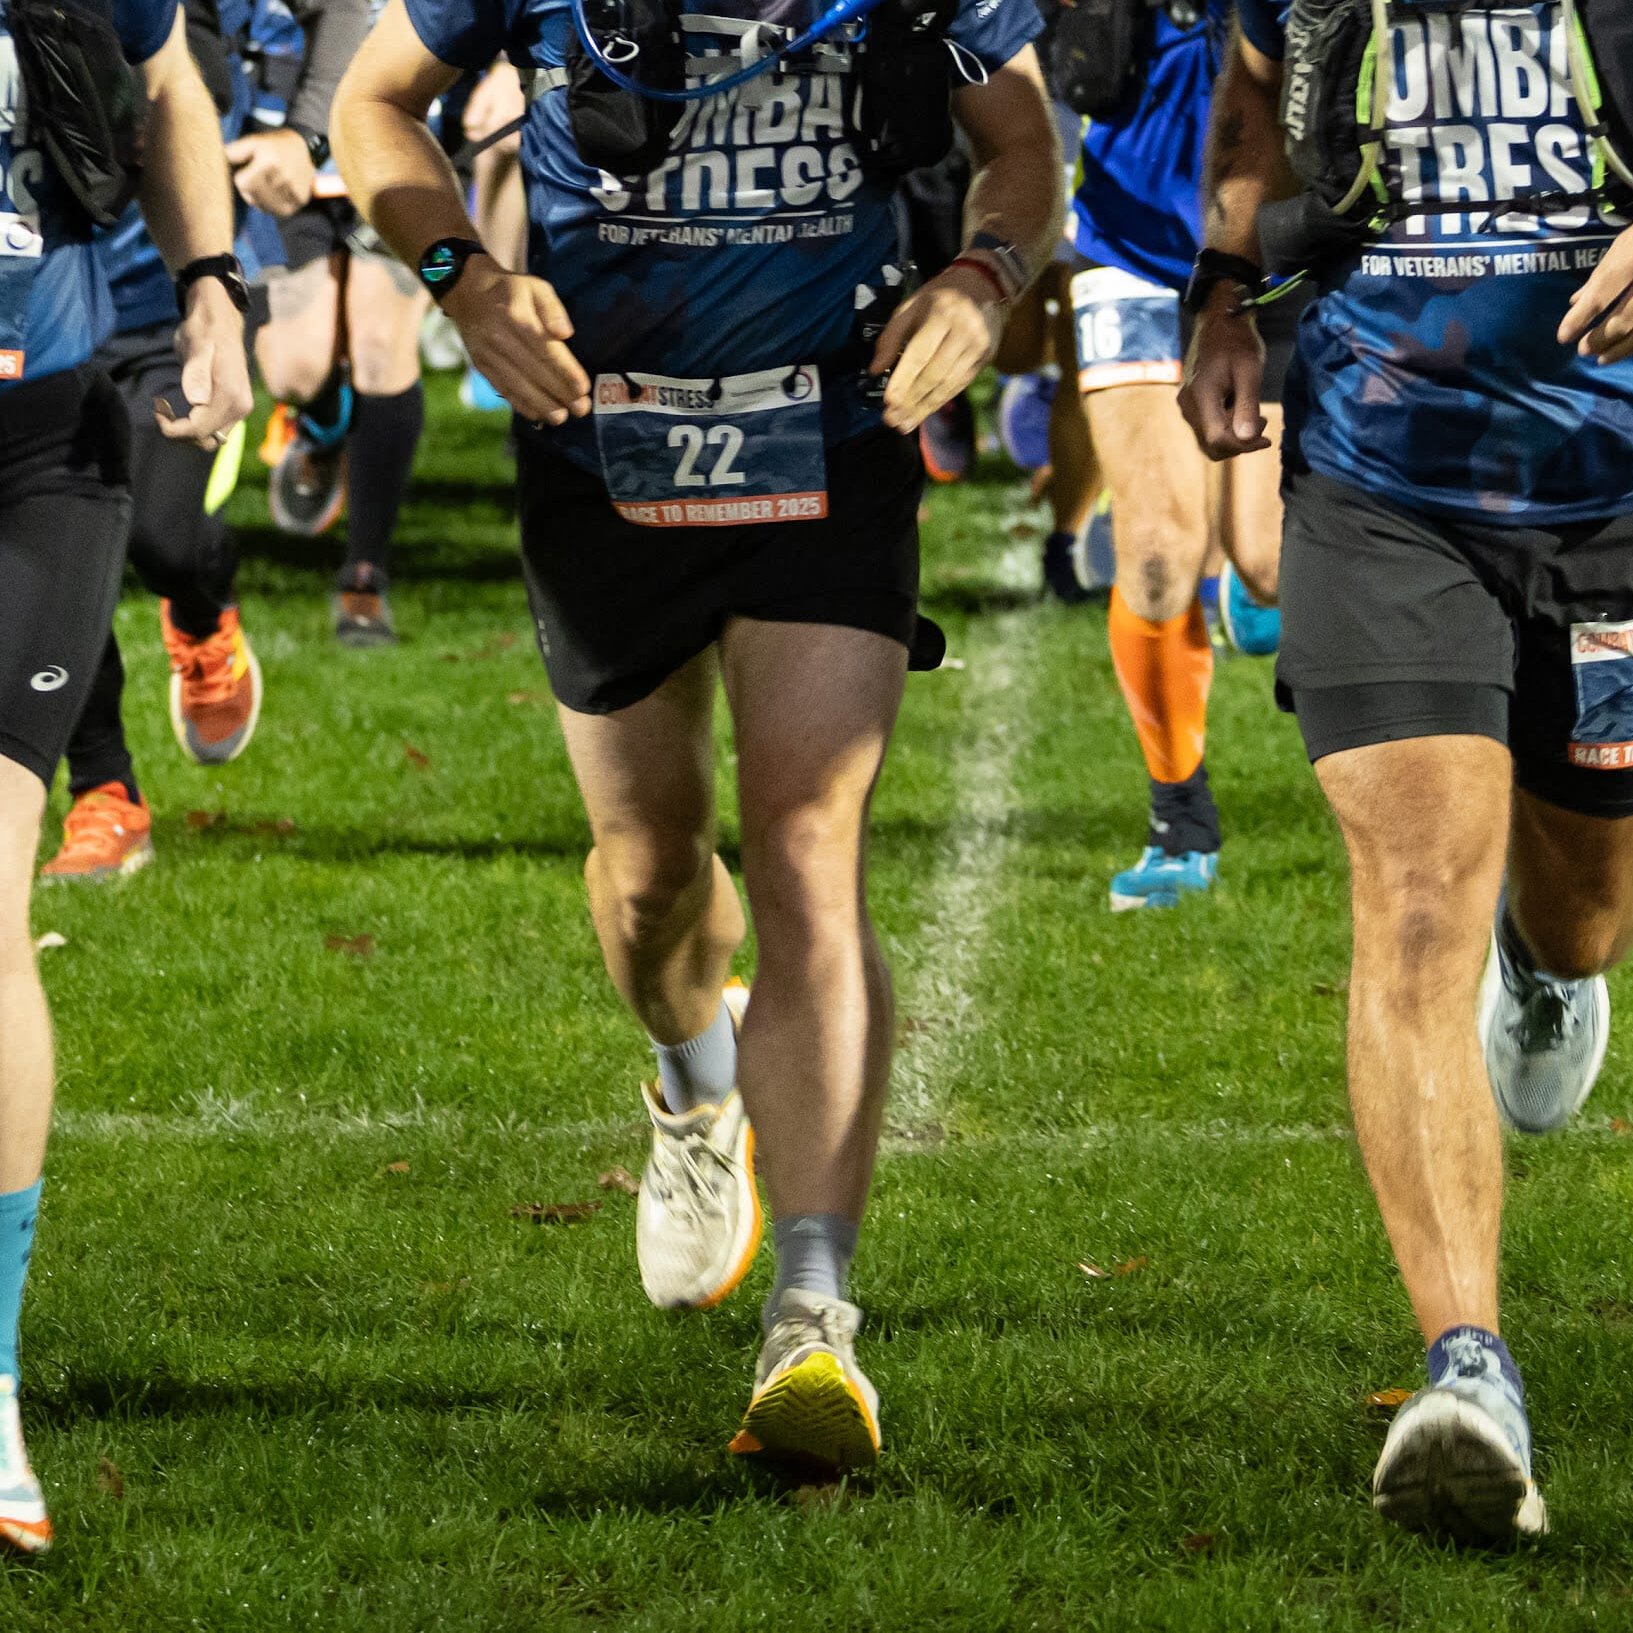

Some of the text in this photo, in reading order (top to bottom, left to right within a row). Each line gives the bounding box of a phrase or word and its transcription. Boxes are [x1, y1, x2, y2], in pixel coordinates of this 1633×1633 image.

[1385, 3, 1578, 123] OMBA
[1378, 123, 1630, 235] TRES
[598, 222, 630, 243] FOR
[1361, 254, 1391, 275] FOR
[1493, 248, 1572, 276] MENTAL
[1574, 247, 1611, 268] HEA
[668, 424, 746, 487] 22
[661, 504, 684, 523] TO
[686, 499, 773, 523] REMEMBER
[776, 496, 821, 517] 2025
[1574, 747, 1620, 764] RACE
